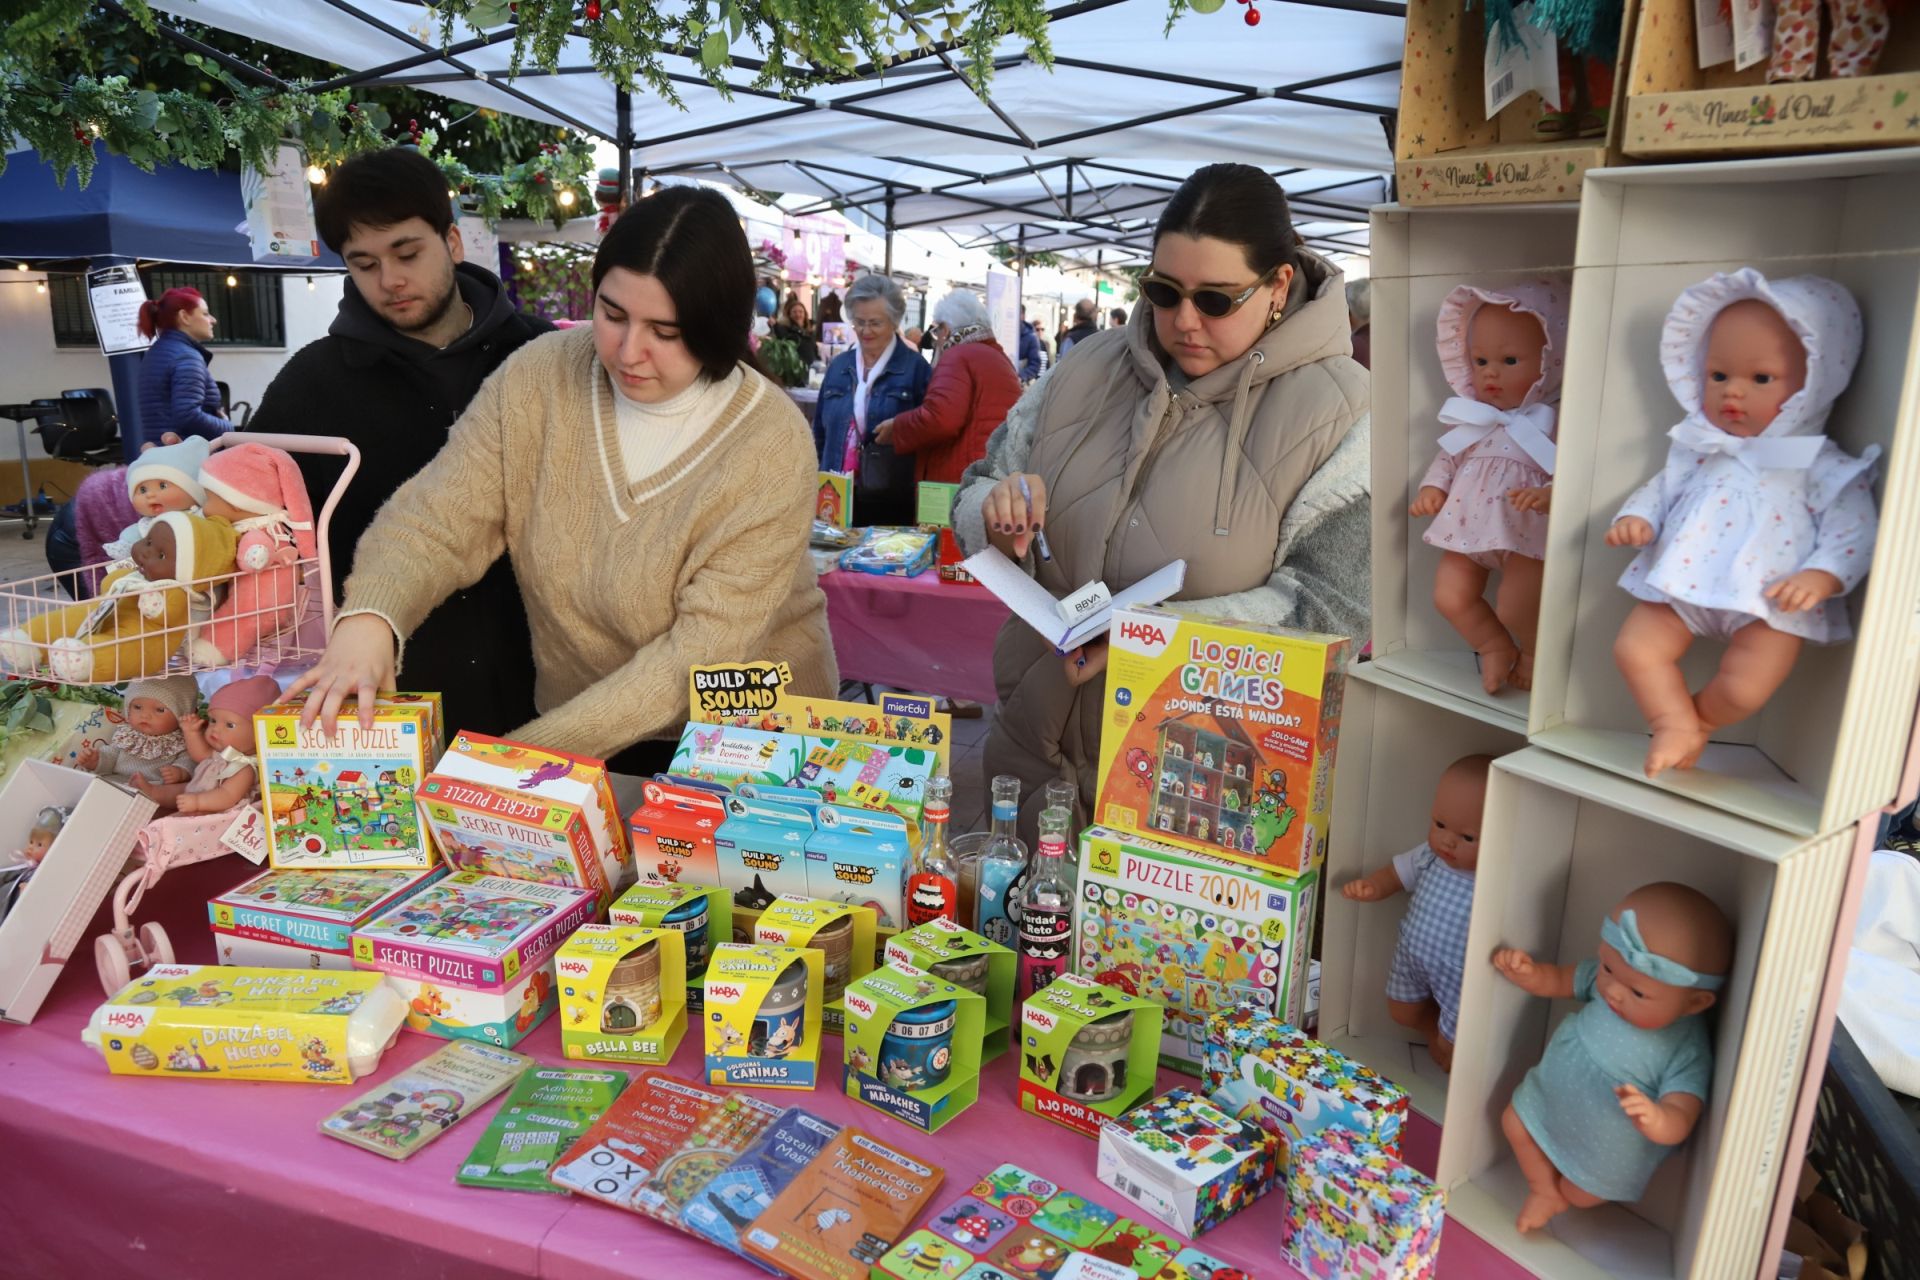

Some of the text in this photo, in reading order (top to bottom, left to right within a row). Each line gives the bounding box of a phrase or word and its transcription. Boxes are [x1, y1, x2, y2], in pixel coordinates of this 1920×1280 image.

[1703, 101, 1749, 128] Nines
[1446, 166, 1477, 188] Nines
[1075, 593, 1101, 613] BBVA
[1120, 622, 1167, 646] HABA
[695, 671, 744, 689] BUILD
[1181, 664, 1284, 710] GAMES
[702, 689, 777, 709] SOUND
[1116, 691, 1130, 702] 4+
[732, 709, 758, 717] PUZZLE
[887, 702, 926, 716] mierEdu
[1164, 697, 1302, 728] ¿DÓNDE ESTÁ WANDA?
[353, 728, 399, 750] PUZZLE
[1271, 730, 1310, 748] SOLO-GAME
[400, 768, 411, 777] 24
[444, 784, 492, 807] PUZZLE
[508, 800, 543, 818] SECRET
[461, 815, 553, 848] SECRET PUZZLE
[657, 836, 679, 847] BUILD
[659, 844, 692, 857] SOUND
[742, 850, 765, 860] BUILD
[745, 858, 778, 870] SOUND
[834, 863, 858, 873] BUILD
[835, 871, 872, 883] SOUND
[1126, 858, 1261, 912] PUZZLE ZOOM
[475, 878, 568, 900] SECRET PUZZLE
[1270, 896, 1282, 907] 3+
[614, 913, 640, 925] HABA
[1021, 910, 1056, 925] Verdad
[240, 913, 281, 932] SECRET
[286, 919, 330, 941] PUZZLE
[912, 928, 936, 941] AJO
[1027, 924, 1053, 935] Reto
[1267, 920, 1281, 934] 24
[523, 907, 585, 965] SECRET PUZZLE
[759, 930, 786, 944] HABA
[154, 966, 191, 977] HABA
[380, 948, 424, 969] SECRET
[429, 955, 475, 980] PUZZLE
[560, 961, 589, 974] HABA
[233, 976, 306, 988] DANZA
[248, 985, 318, 996] HUEVO
[709, 986, 741, 1000] HABA
[1046, 986, 1073, 998] AJO
[848, 995, 873, 1014] HABA
[1047, 994, 1096, 1018] POR AJO
[108, 1012, 145, 1029] HABA
[1026, 1010, 1053, 1028] HABA
[203, 1023, 295, 1045] DANZA DEL
[901, 1021, 944, 1036] 06 07 08
[223, 1043, 282, 1062] HUEVO
[586, 1040, 658, 1056] BELLA BEE
[726, 1060, 762, 1072] GOLOSINAS
[731, 1067, 789, 1080] CANINAS
[538, 1084, 584, 1094] Adivina
[869, 1090, 921, 1113] MAPACHES
[1037, 1099, 1061, 1112] AJO
[1063, 1103, 1085, 1119] POR
[1265, 1099, 1289, 1121] MINIS
[650, 1104, 665, 1114] en
[667, 1108, 696, 1124] Raya
[857, 1137, 911, 1168] THE PURPLE COW
[835, 1146, 851, 1158] El
[852, 1157, 924, 1195] Ahorcado
